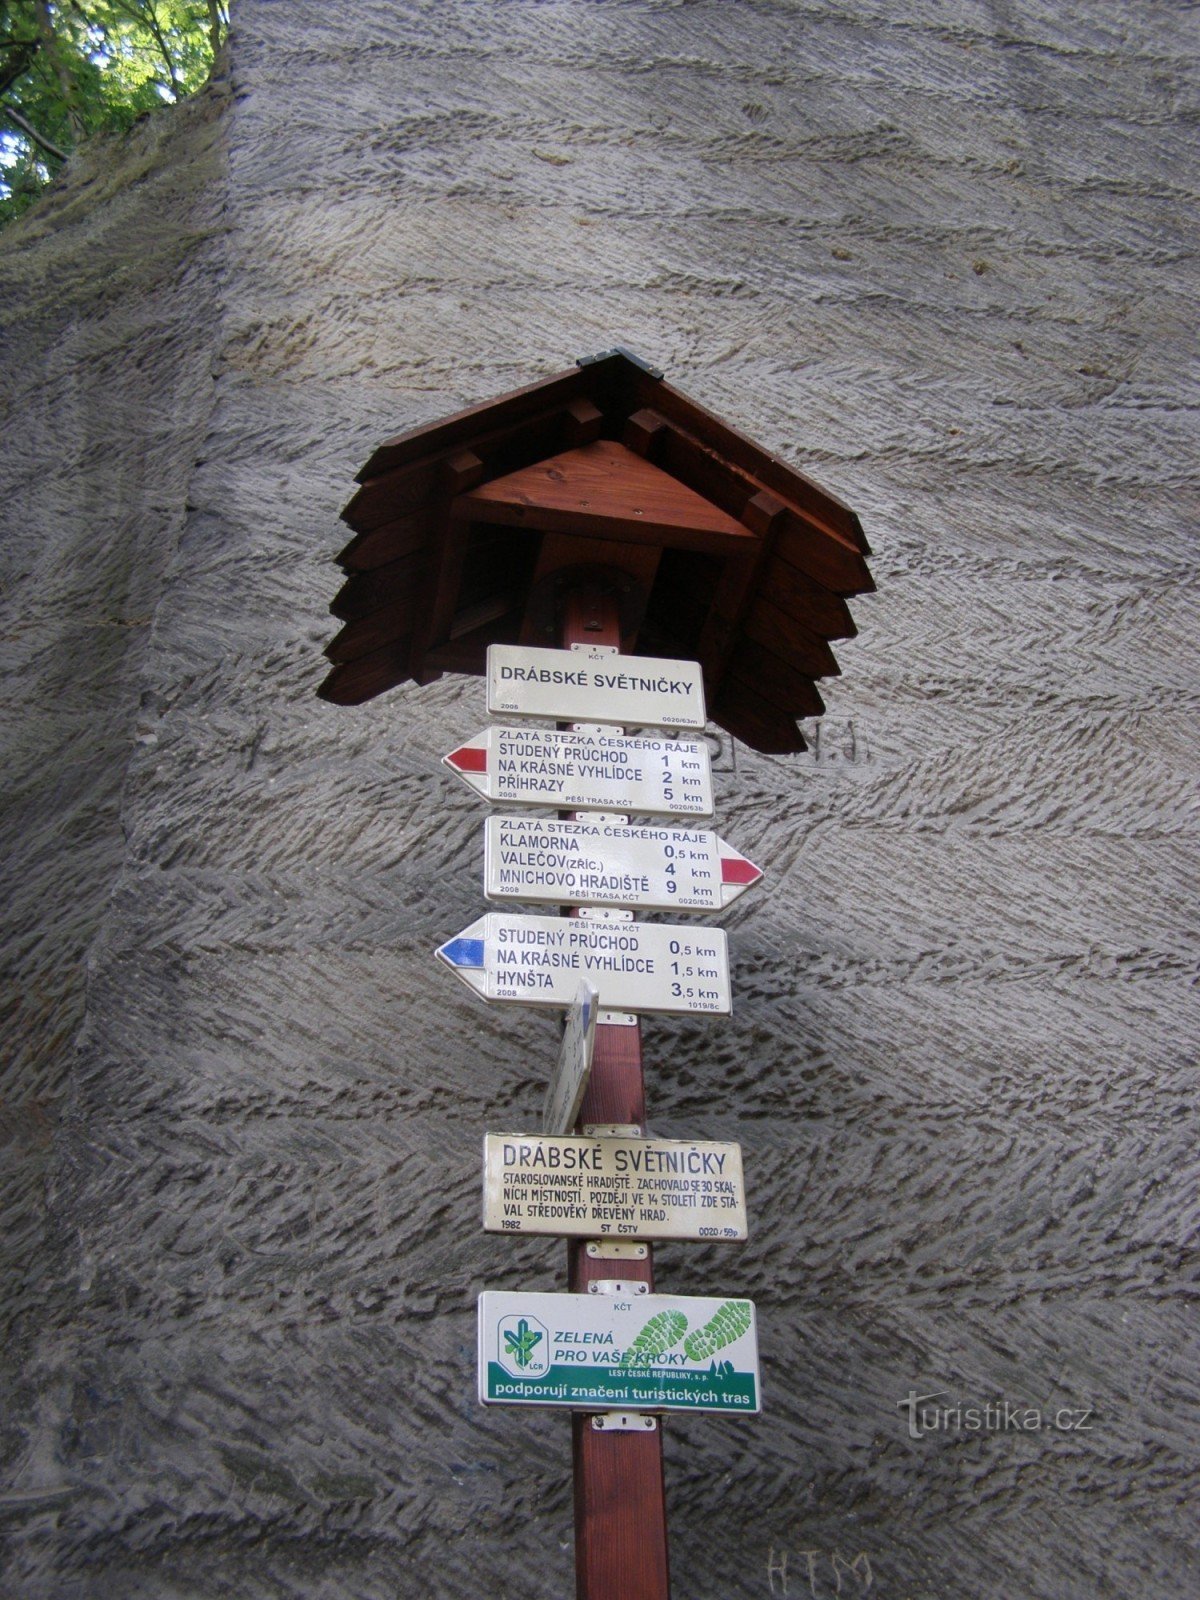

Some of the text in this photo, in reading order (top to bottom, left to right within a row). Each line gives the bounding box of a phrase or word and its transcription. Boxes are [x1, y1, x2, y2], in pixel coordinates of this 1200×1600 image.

[501, 666, 693, 695] DRÁBSKÉ SVĚTNIČKY
[499, 730, 698, 754] ZLATÁ STEZKA ČESKÉHO RÁJE
[500, 743, 700, 769] STUDENÝ PRŮCHOD 1 km
[499, 760, 701, 786] NA KRÁSNÉ VYHLÍDCE 2 km
[498, 774, 703, 803] PŘÍHRAZY 5 km
[565, 795, 584, 803] PĚŠÍ
[500, 820, 707, 844] ZLATÁ STEZKA ČESKÉHO RÁJE
[500, 834, 708, 860] KLAMORNA 0,5 km
[665, 863, 675, 875] 4
[691, 868, 710, 878] km
[500, 869, 712, 896] MNICHOVO HRADIŠTĚ 9 km
[570, 890, 589, 898] PĚŠÍ
[591, 892, 619, 900] TRASA
[622, 893, 639, 901] KČT
[569, 921, 588, 929] PĚŠÍ
[622, 924, 640, 932] KČT
[499, 929, 716, 957] STUDENÝ PRŮCHOD 0,5 km
[498, 948, 717, 978] NA KRÁSNÉ VYHLÍDCE 1,5 km
[497, 971, 718, 999] HYNŠTA 3,5 km
[497, 989, 516, 997] 2008
[504, 1142, 725, 1175] DRÁBSKÉ SVĚTNIČKY
[504, 1172, 736, 1193] STAROSLOVANSKÉ HRADIŠTĚ. ZACHOVALO SE 30 SKAL-
[504, 1186, 527, 1201] NÍCH
[532, 1187, 585, 1202] MÍSTNOSTÍ.
[590, 1189, 627, 1204] POZDĚJI
[632, 1194, 644, 1205] VE
[648, 1194, 657, 1205] 14
[662, 1192, 696, 1207] STOLETÍ
[701, 1196, 718, 1207] ZDE
[504, 1203, 669, 1221] VAL STŘEDOVĚKÝ DŘEVĚNÝ HRAD.
[502, 1220, 521, 1229] 1982
[601, 1224, 611, 1232] ST
[618, 1223, 638, 1233] ČSTV
[614, 1303, 632, 1312] KČT
[554, 1330, 614, 1344] ZELENÁ
[529, 1362, 543, 1370] LČR
[554, 1350, 688, 1366] PRO VAŠE KROKY
[609, 1369, 626, 1377] LESY
[628, 1368, 648, 1378] ČESKÉ
[652, 1371, 693, 1380] REPUBLIKY,
[495, 1382, 750, 1404] podporují značení turistických tras
